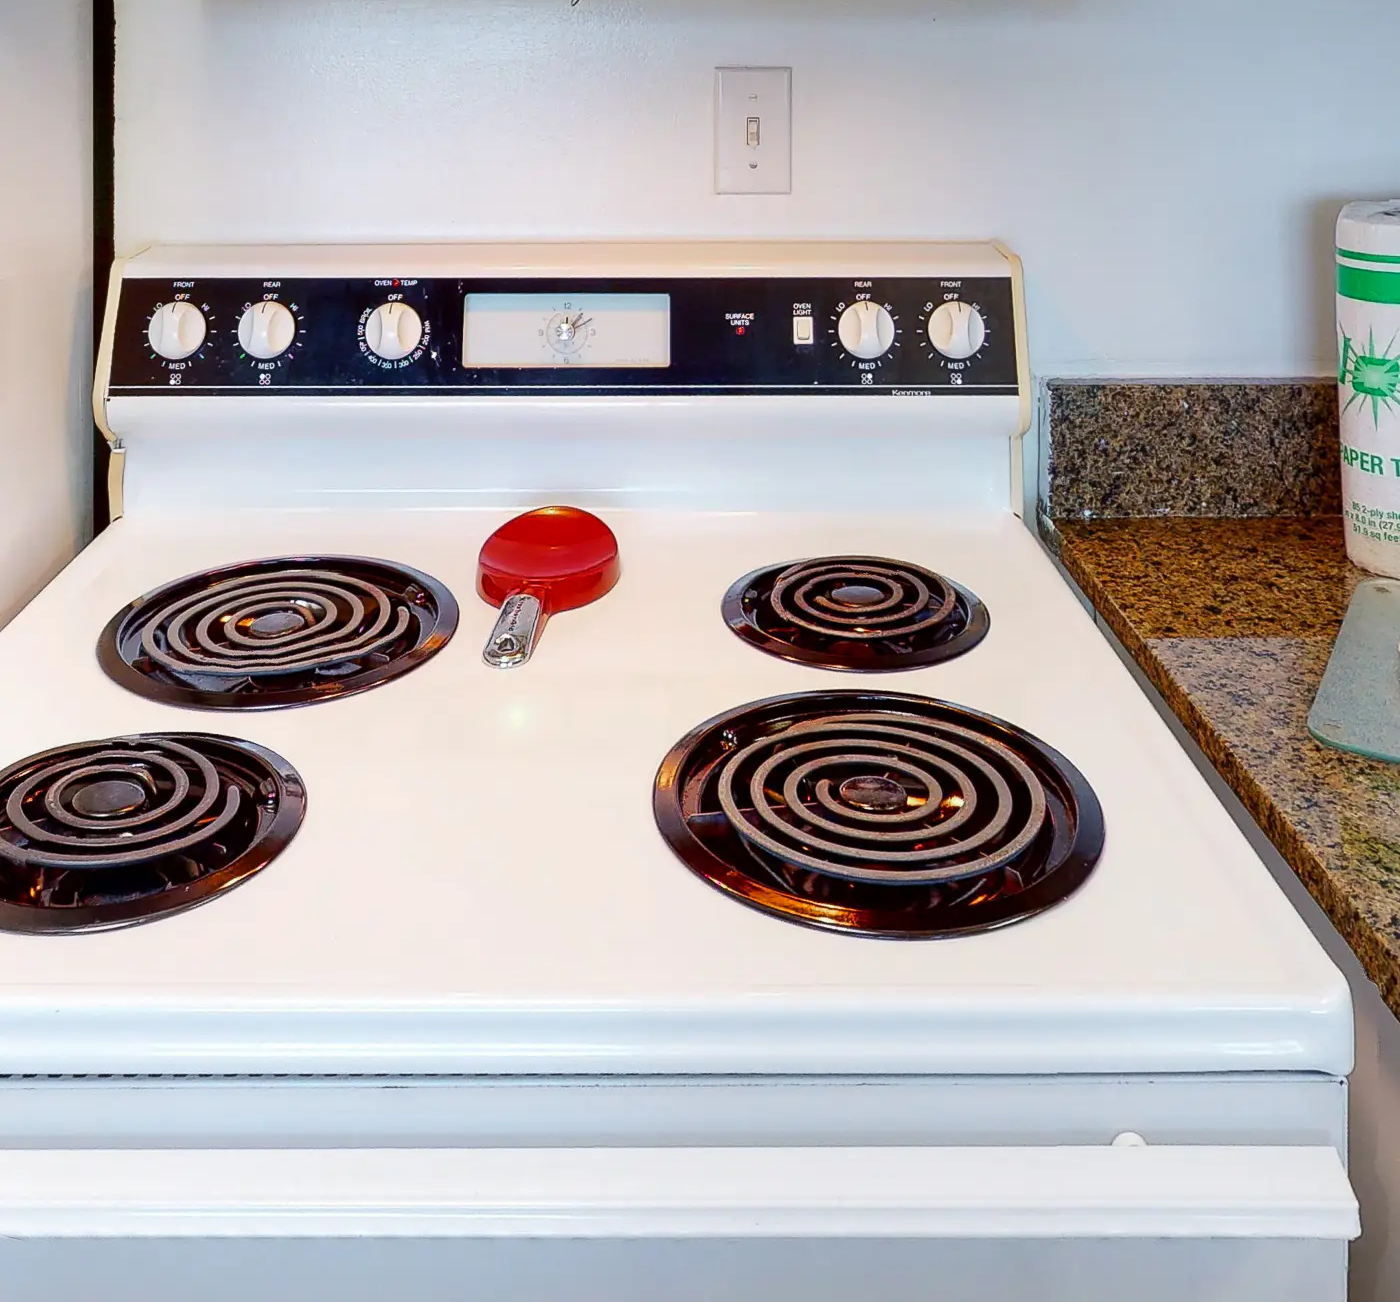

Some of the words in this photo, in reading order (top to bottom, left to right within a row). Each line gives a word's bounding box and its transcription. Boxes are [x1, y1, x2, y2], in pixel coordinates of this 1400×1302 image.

[201, 303, 210, 311] HI
[242, 302, 252, 311] LO
[290, 303, 299, 311] HI
[836, 302, 846, 312] LO
[923, 302, 934, 312] LO
[168, 362, 186, 370] MED
[258, 362, 275, 370] MED
[858, 362, 876, 370] MED
[947, 362, 965, 370] MED
[1340, 442, 1384, 476] PAPER
